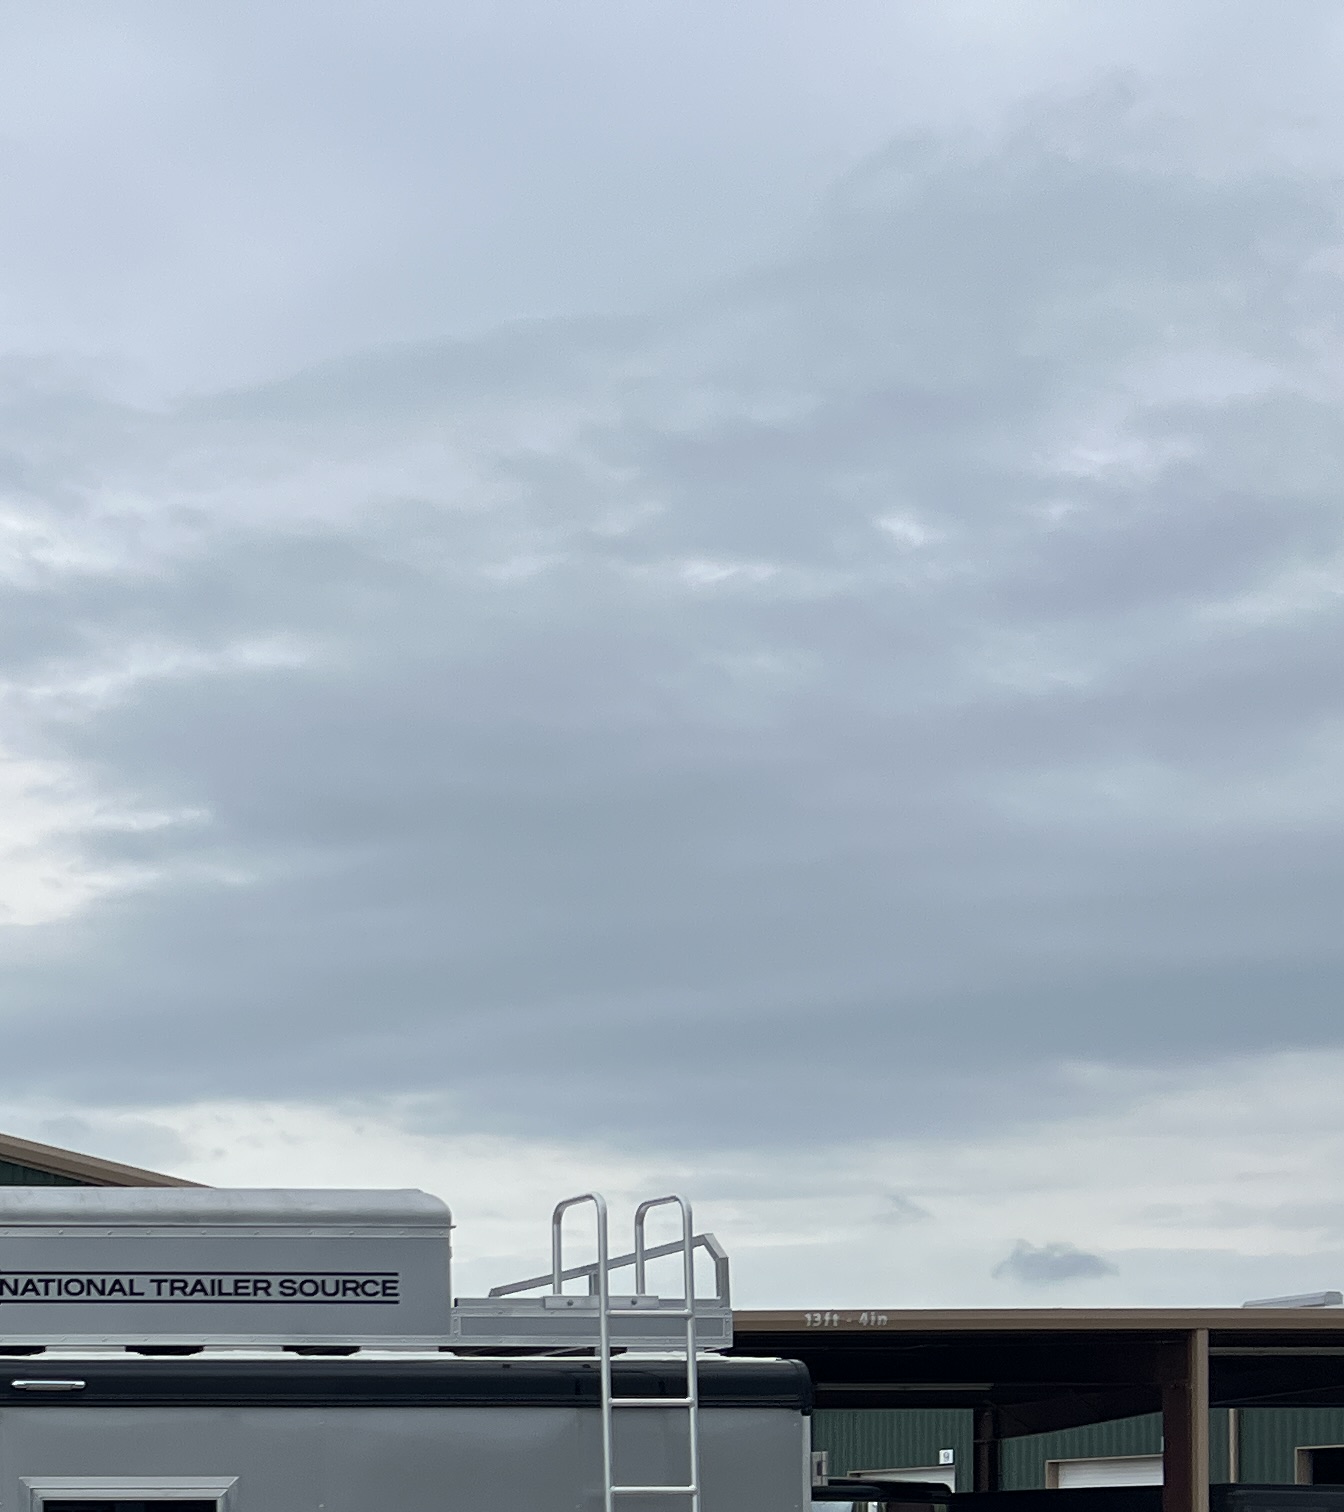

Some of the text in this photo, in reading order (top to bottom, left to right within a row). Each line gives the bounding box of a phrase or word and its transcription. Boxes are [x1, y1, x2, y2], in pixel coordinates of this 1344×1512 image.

[150, 1278, 272, 1297] TRAILER
[279, 1279, 400, 1297] SOURCE
[804, 1311, 840, 1327] 13ft
[858, 1311, 888, 1326] 4in
[943, 1451, 950, 1462] 9
